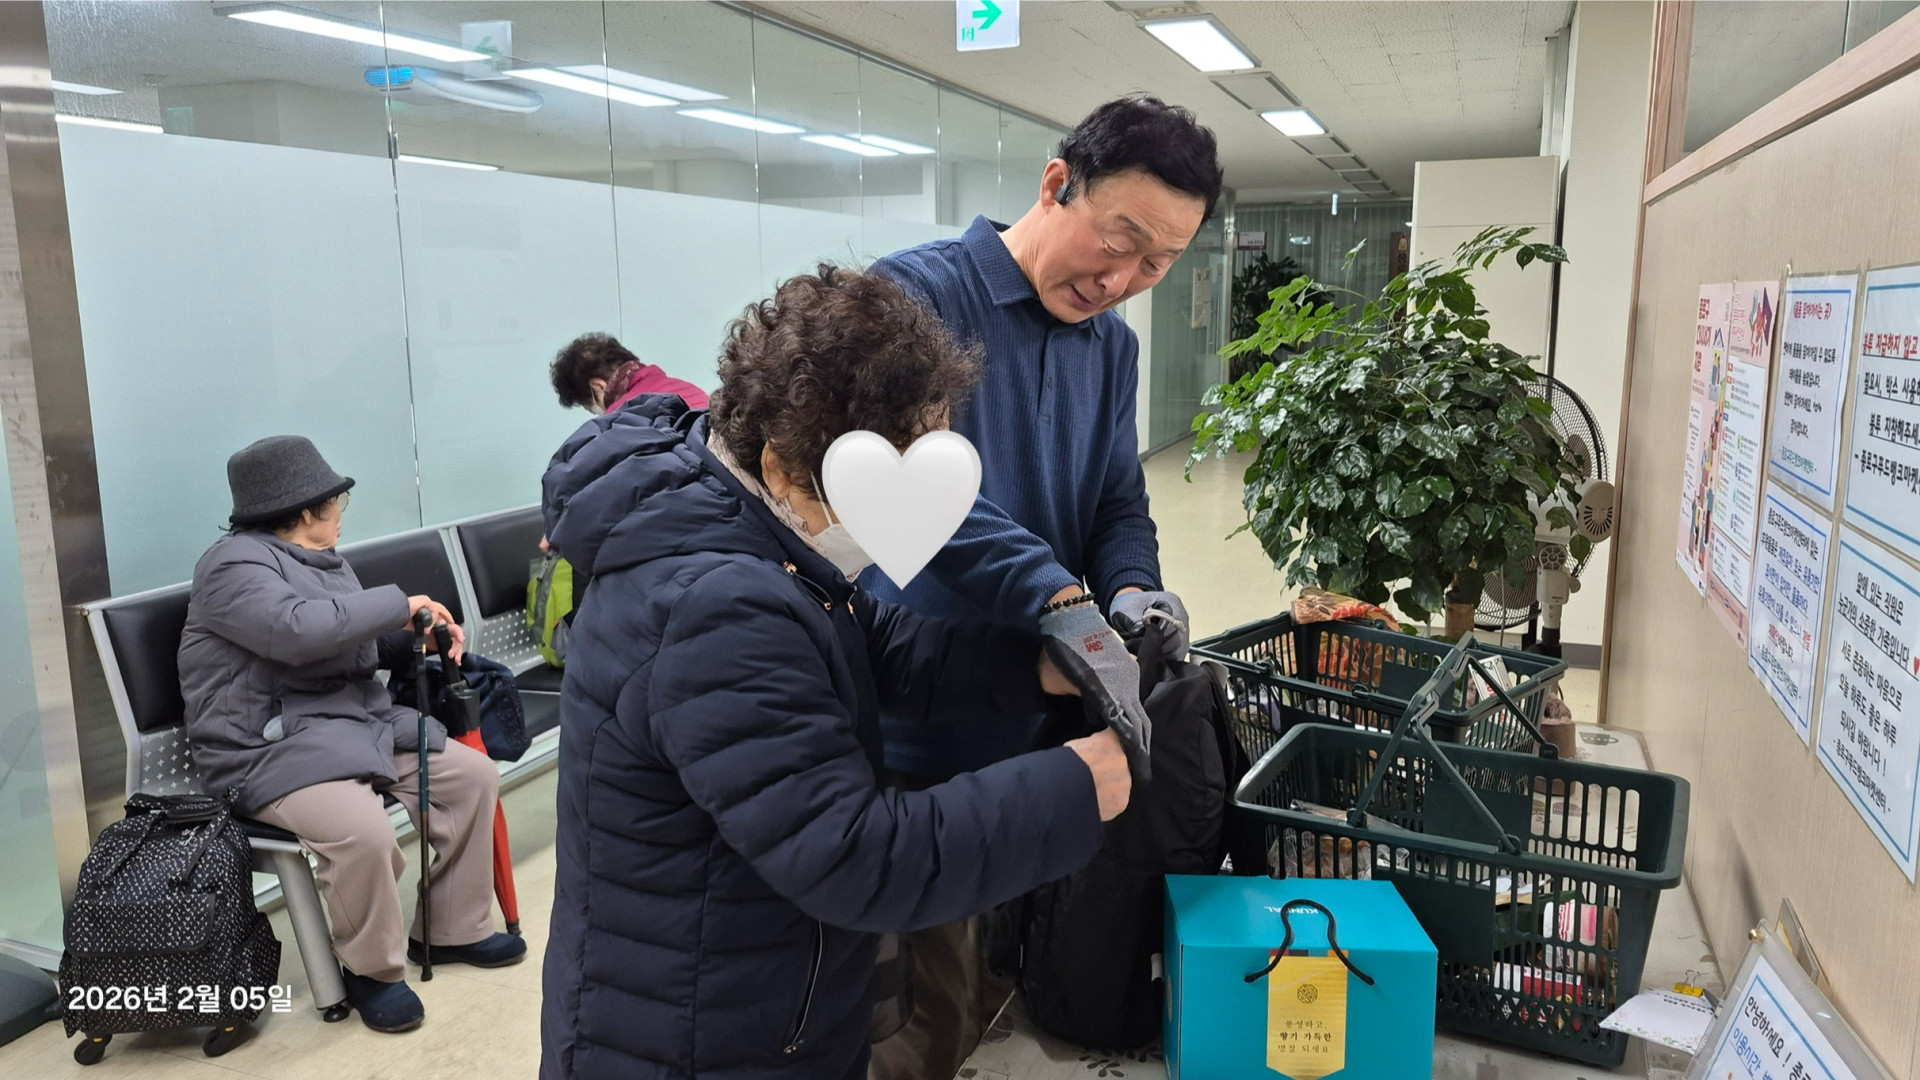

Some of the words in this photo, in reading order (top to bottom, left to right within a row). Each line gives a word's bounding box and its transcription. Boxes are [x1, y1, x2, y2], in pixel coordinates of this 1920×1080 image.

[1862, 332, 1874, 355] 봉투
[1876, 332, 1901, 357] 지급하지
[1903, 335, 1918, 360] 않고
[1864, 371, 1882, 395] 필요시,
[1885, 375, 1898, 399] 박스
[1869, 412, 1881, 436] 봉투
[1884, 416, 1920, 446] 지참해주세
[1860, 449, 1920, 496] 종로구푸드뱅크마켓
[1856, 572, 1869, 597] 앞에
[1870, 582, 1882, 608] 있는
[1884, 592, 1904, 626] 직원은
[1838, 592, 1858, 624] 누군가의
[1859, 611, 1876, 643] 소중한
[1877, 626, 1910, 671] 가족입니다
[1841, 639, 1851, 663] 서로
[1853, 651, 1874, 689] 존중하는
[1876, 673, 1903, 713] 마음으로
[1839, 673, 1849, 699] 오늘
[1850, 684, 1867, 716] 하루도
[1868, 703, 1881, 733] 좋은
[1883, 718, 1897, 748] 하루
[1840, 710, 1856, 743] 되시길
[1857, 728, 1881, 772] 바랍니다
[1836, 738, 1887, 814] 종로구푸드뱅크마켓센터
[1264, 906, 1318, 914] KUNAL
[1280, 1031, 1298, 1041] 향기
[1303, 1032, 1331, 1042] 가득한
[1733, 1028, 1762, 1077] 이용시간
[1744, 996, 1785, 1059] 안녕하세요
